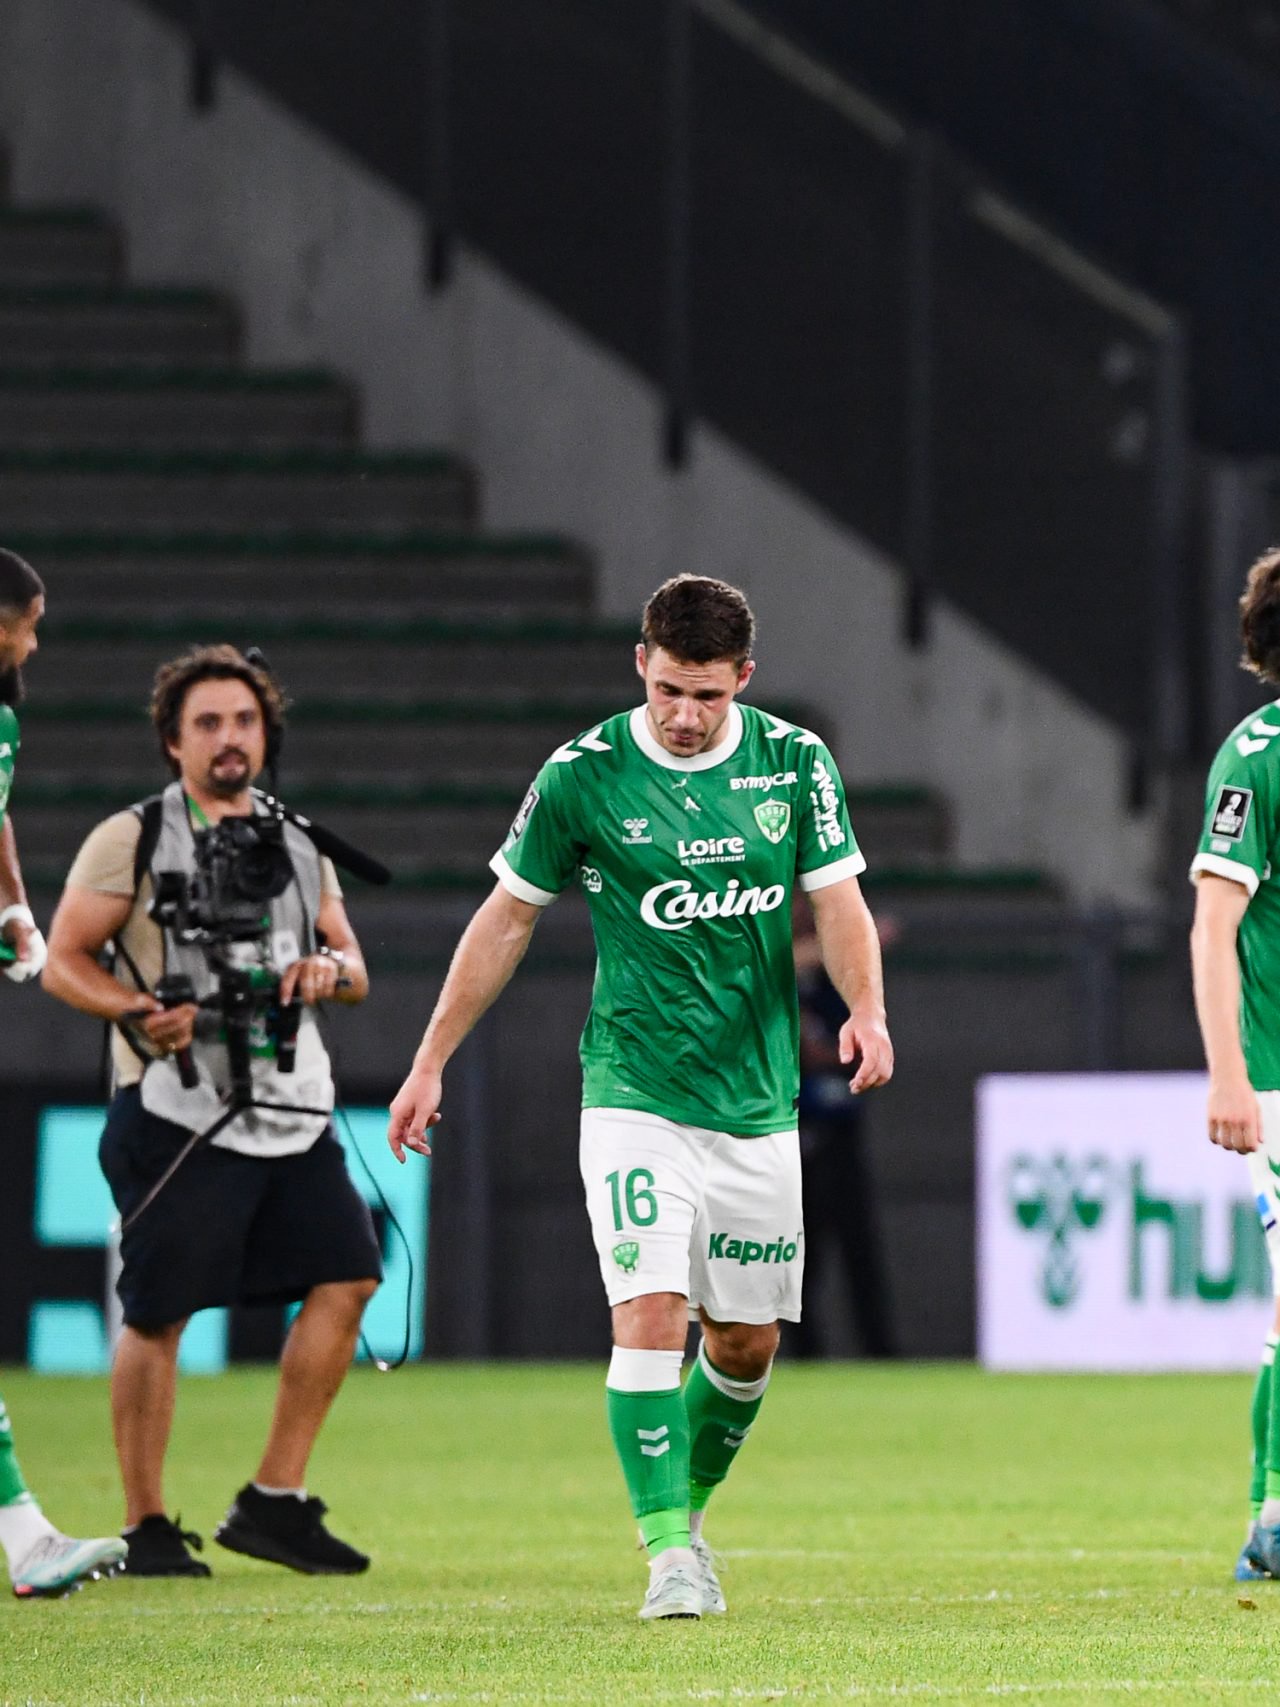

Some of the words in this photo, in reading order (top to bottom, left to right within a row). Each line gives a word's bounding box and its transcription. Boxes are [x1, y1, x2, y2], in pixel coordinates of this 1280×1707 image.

[677, 836, 745, 858] Loire
[640, 879, 785, 931] Casino
[605, 1168, 658, 1231] 16
[708, 1233, 803, 1266] Kaprio
